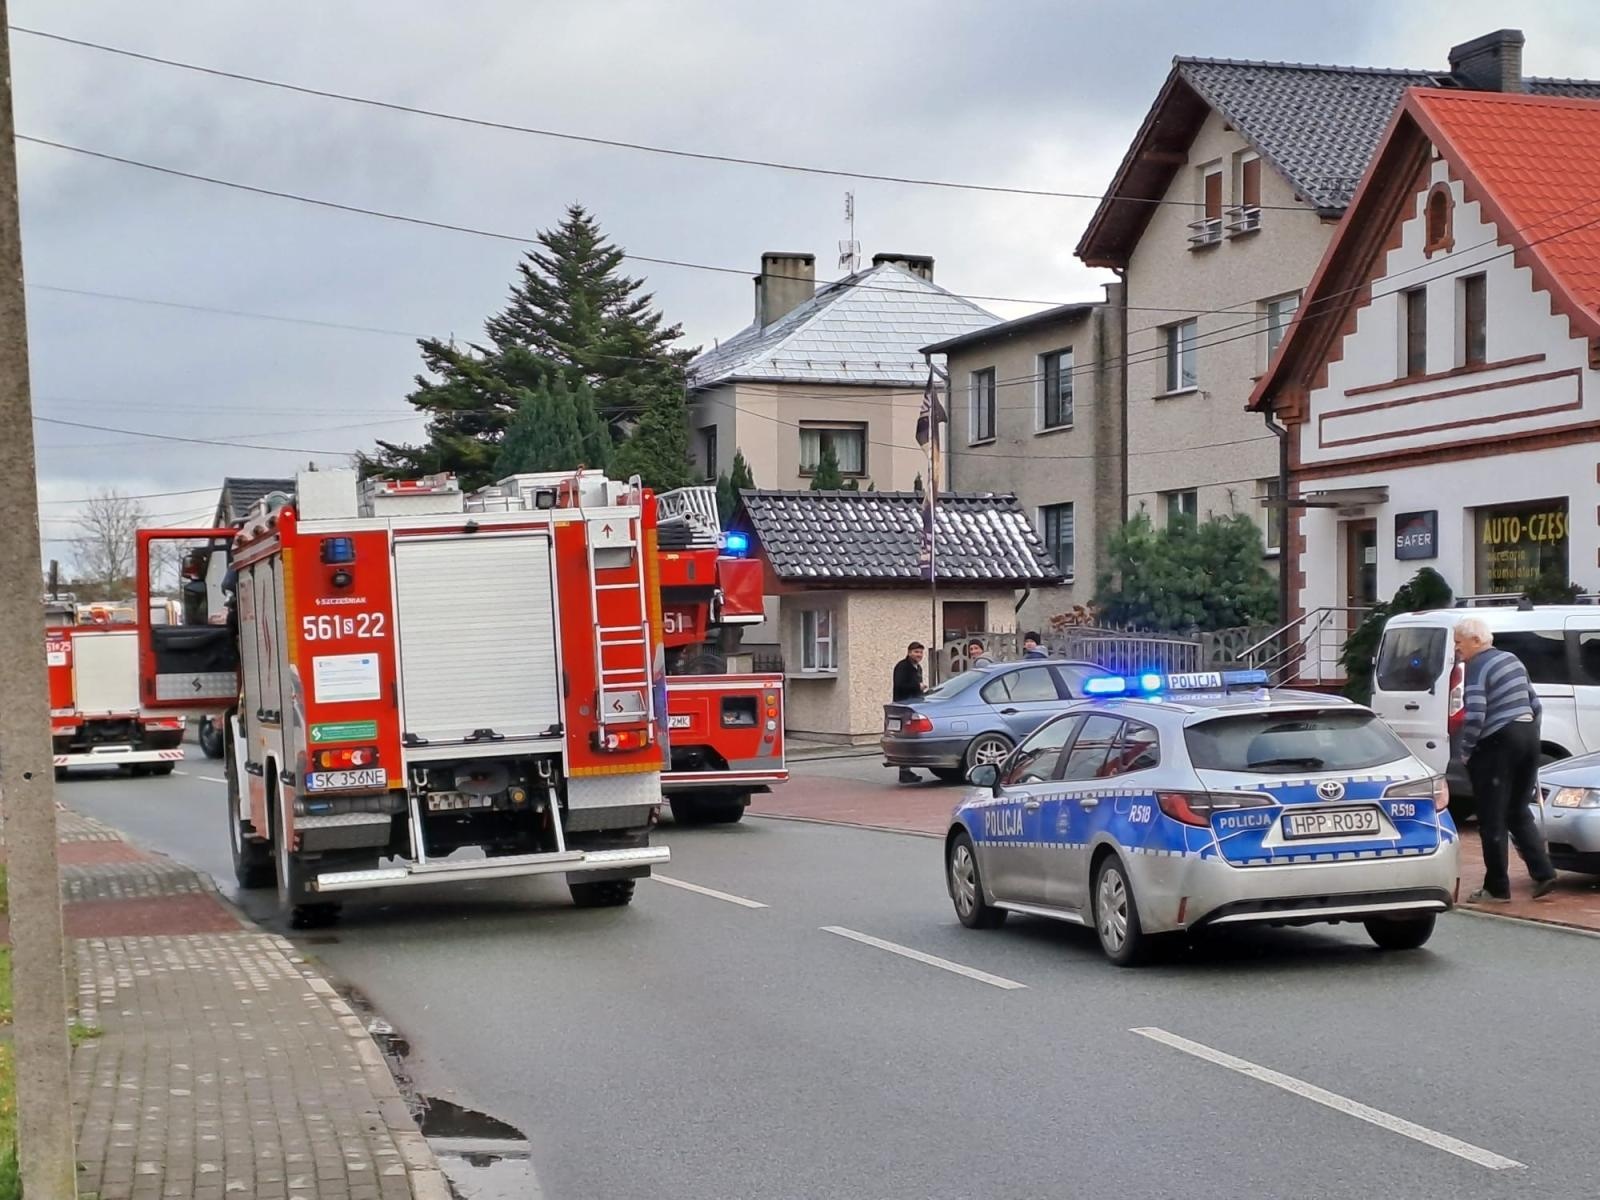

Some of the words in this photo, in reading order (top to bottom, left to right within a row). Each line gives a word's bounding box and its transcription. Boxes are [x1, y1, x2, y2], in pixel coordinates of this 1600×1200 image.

[1397, 533, 1431, 547] SAFER
[1170, 674, 1218, 688] POLICJA
[315, 773, 335, 787] SK
[340, 769, 384, 786] 356NE
[1127, 804, 1152, 824] R518
[1391, 803, 1416, 817] R518
[984, 809, 1024, 836] POLICJA
[1219, 814, 1272, 829] POLICJA
[1294, 814, 1326, 833] HPP
[1334, 812, 1374, 832] R039
